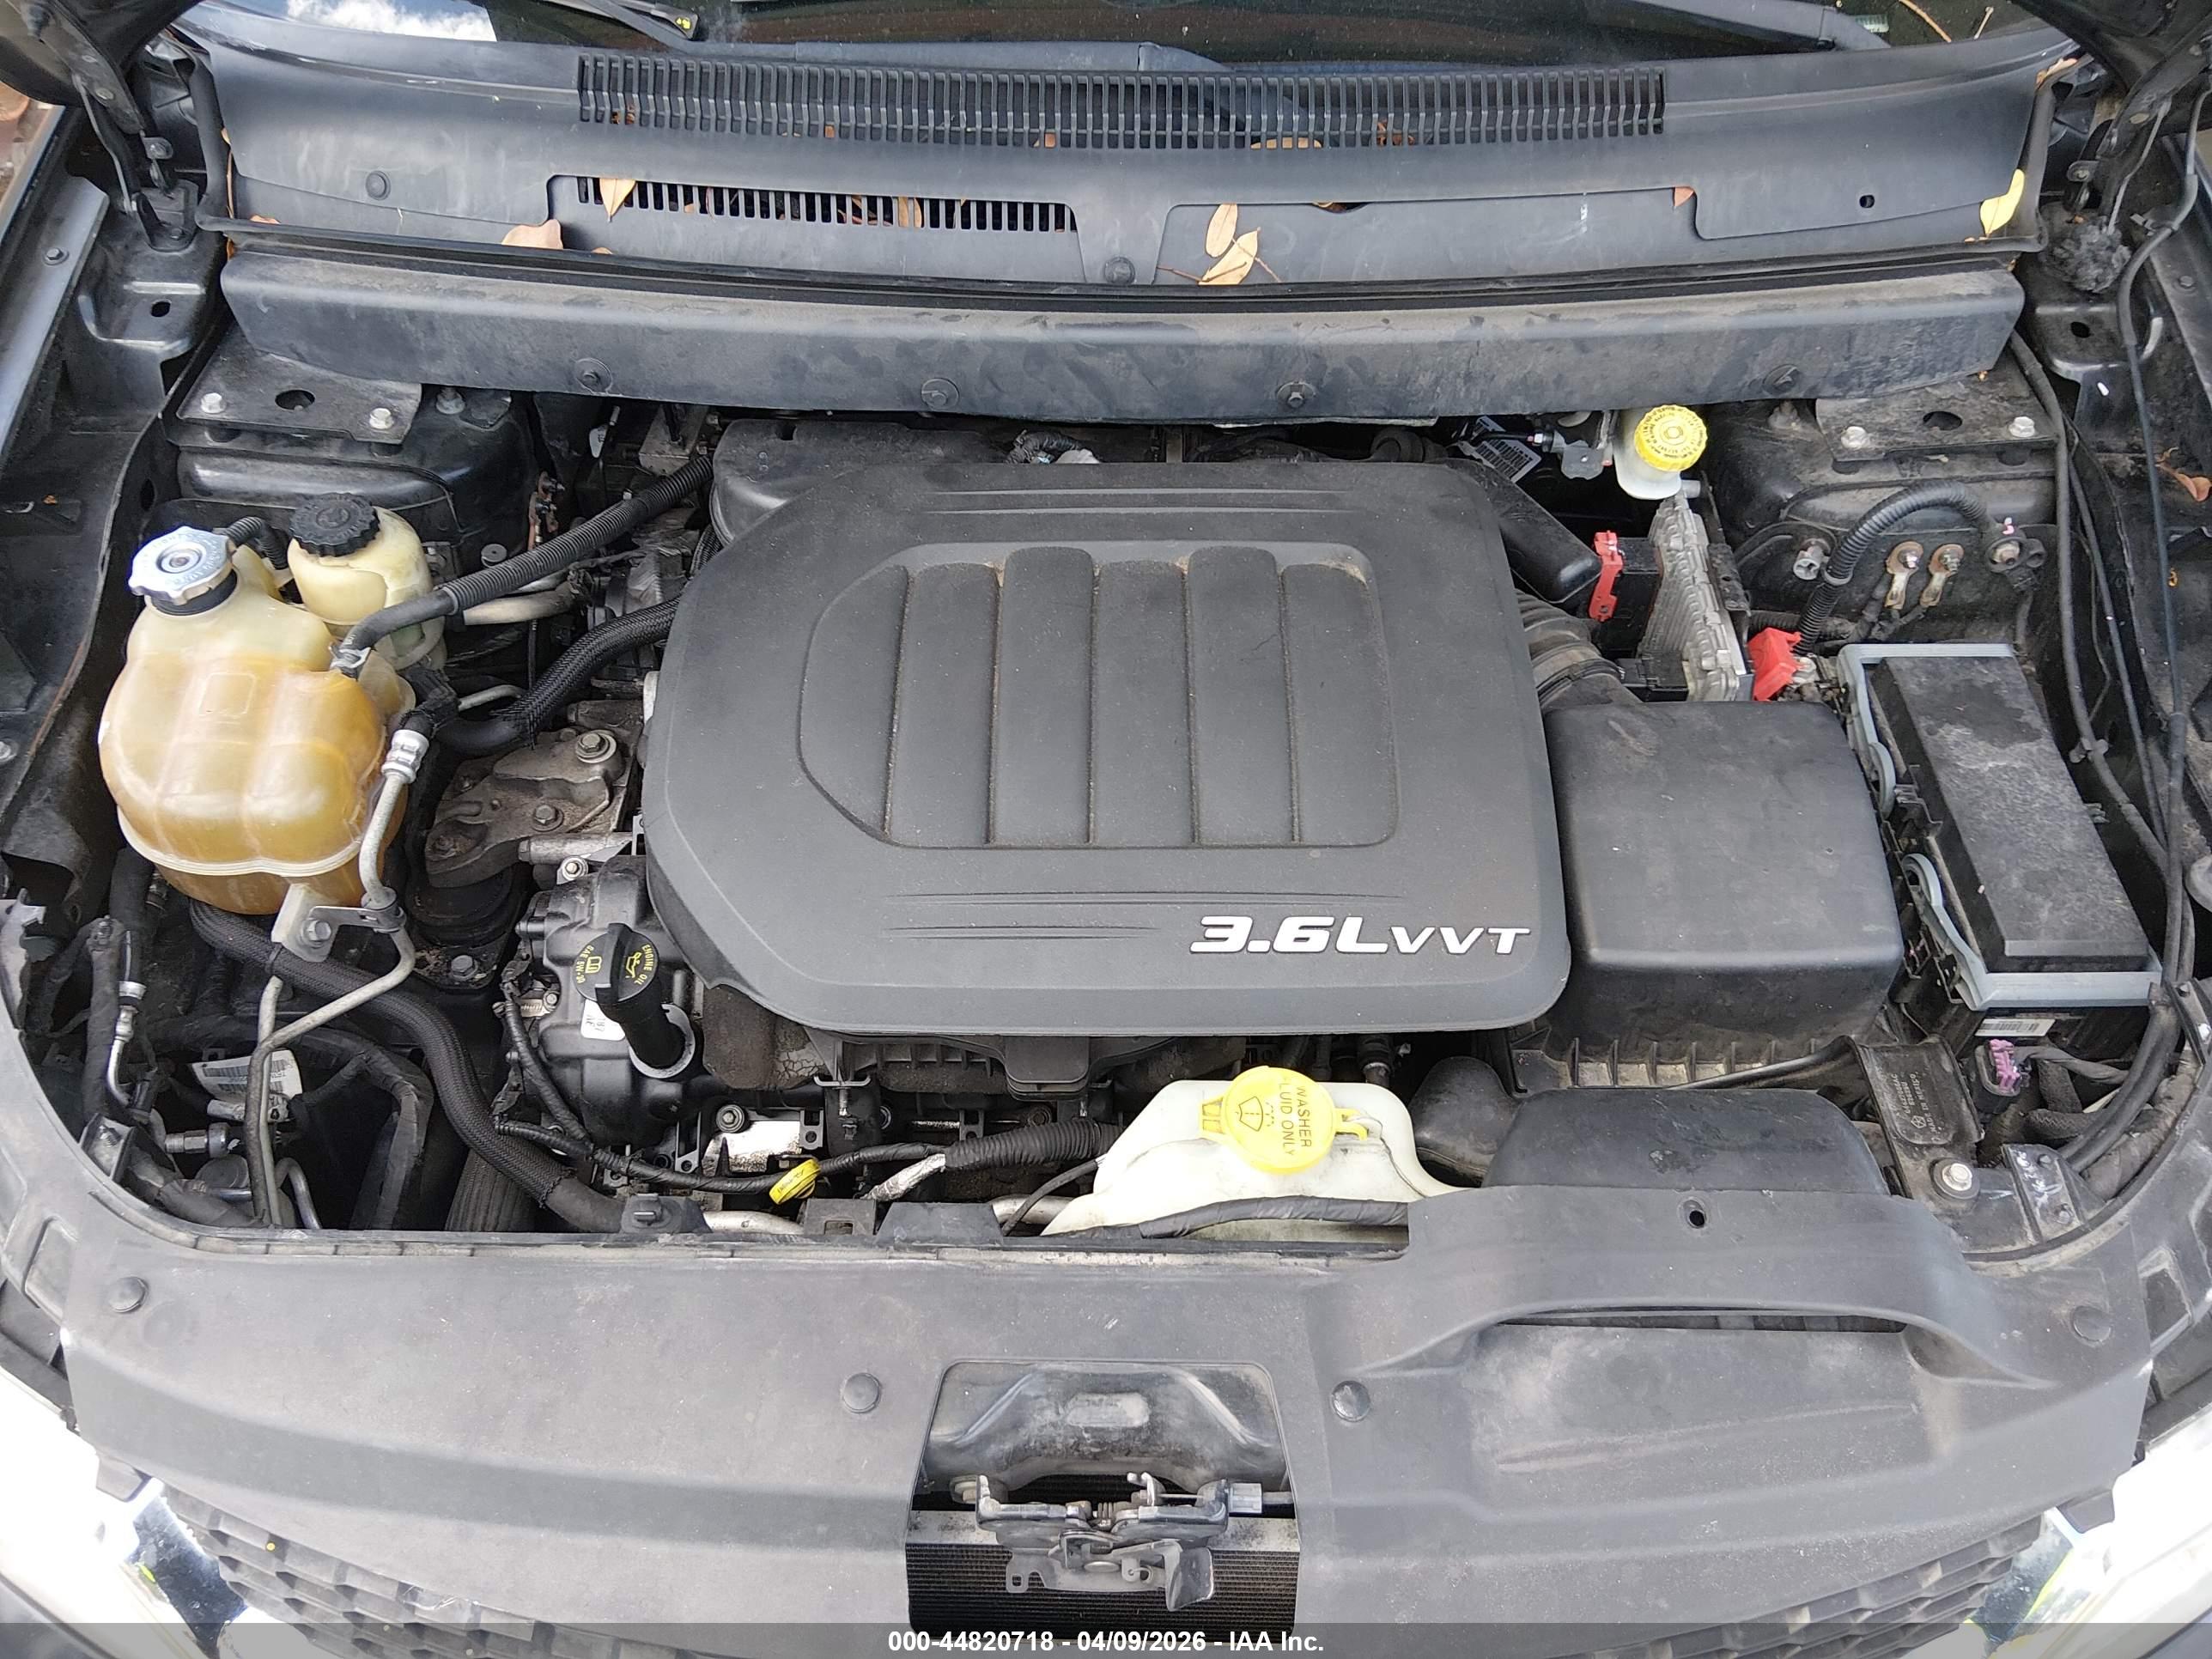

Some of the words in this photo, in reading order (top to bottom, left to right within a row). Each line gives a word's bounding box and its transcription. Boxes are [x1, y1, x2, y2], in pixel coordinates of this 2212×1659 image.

[580, 945, 594, 959] SAE
[1190, 915, 1389, 954] 3.6L
[1389, 927, 1531, 954] VVT
[641, 944, 654, 971] ENGINE
[634, 974, 647, 985] OIL
[1279, 1076, 1292, 1115] LUID
[1296, 1085, 1312, 1147] WASHER
[1281, 1120, 1295, 1156] ONLY
